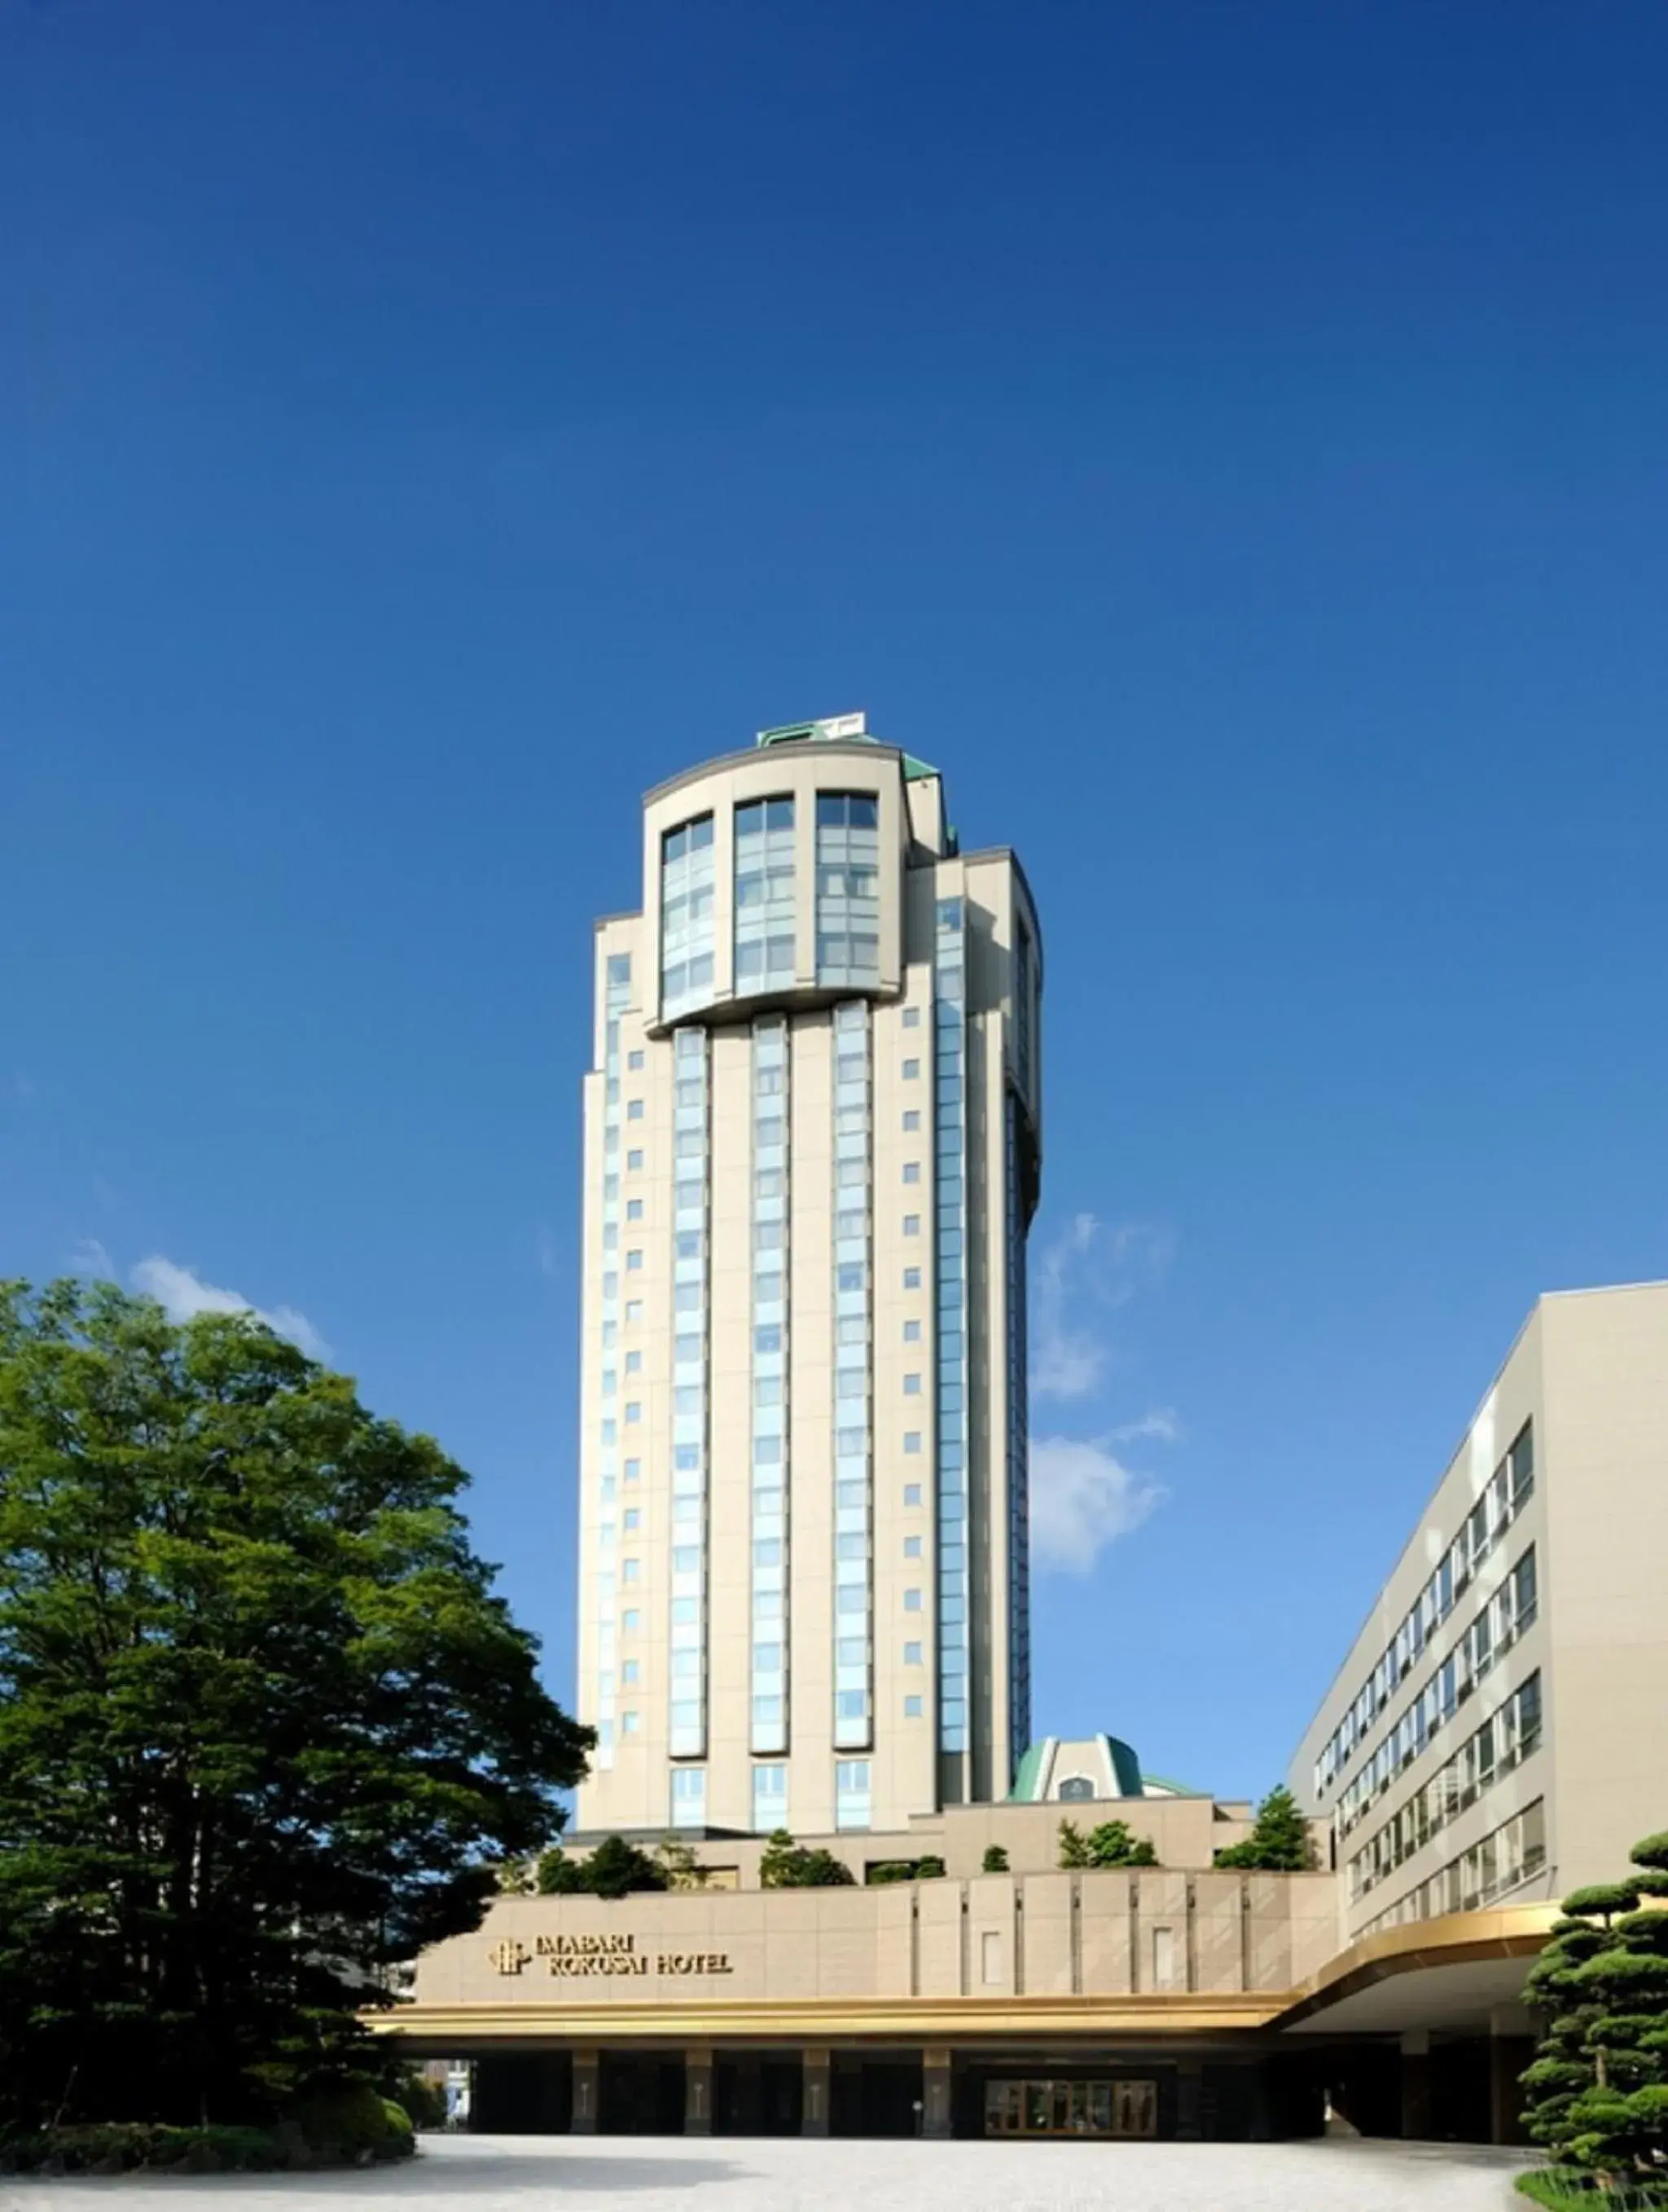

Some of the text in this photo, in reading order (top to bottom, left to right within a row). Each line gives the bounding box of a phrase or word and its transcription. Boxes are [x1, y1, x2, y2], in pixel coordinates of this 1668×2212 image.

[535, 1934, 634, 1955] IMABARI
[549, 1953, 735, 1976] KOKUSAI HOTEL
